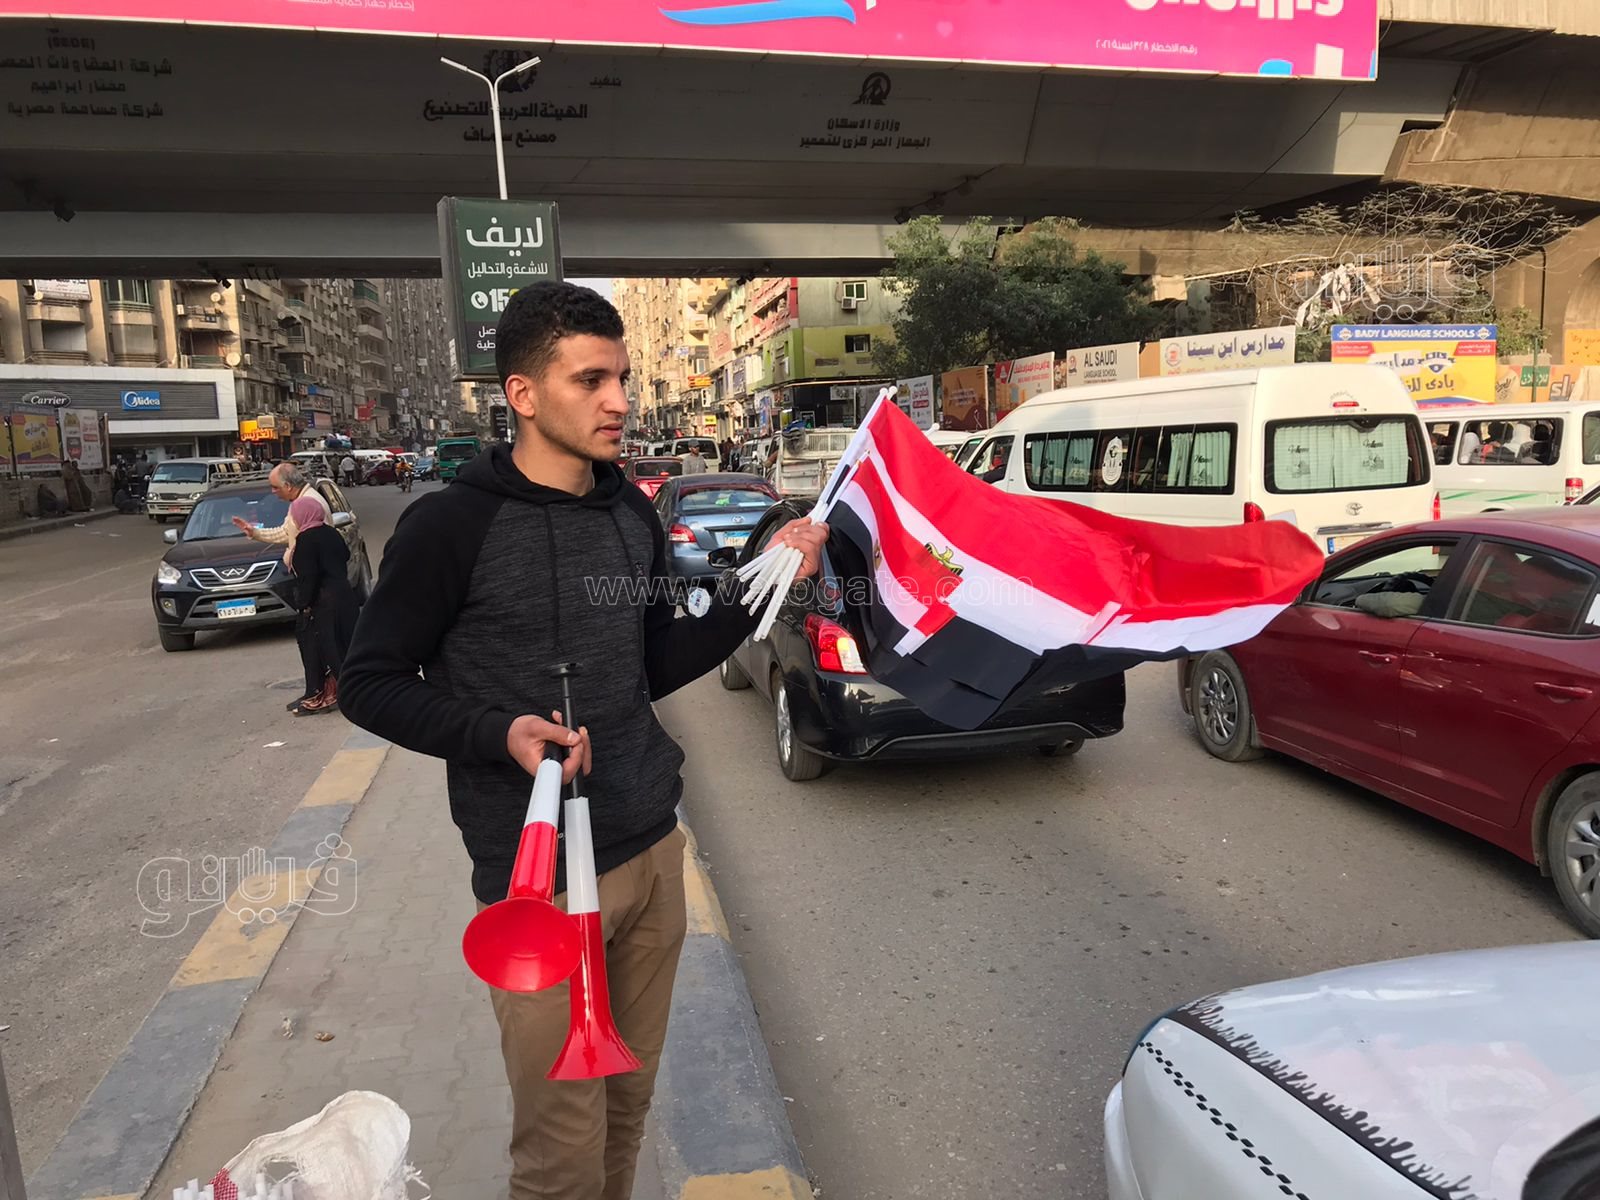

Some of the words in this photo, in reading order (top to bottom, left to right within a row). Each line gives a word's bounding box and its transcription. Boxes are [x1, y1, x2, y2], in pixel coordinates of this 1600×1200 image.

[129, 57, 173, 77] شركة
[61, 102, 118, 116] مساهمة
[122, 102, 164, 119] شركة
[423, 100, 489, 121] للتصنيع
[498, 102, 539, 121] العربي
[541, 103, 588, 121] الهيئة
[873, 118, 901, 133] وزارة
[515, 127, 557, 148] مصنع
[466, 217, 544, 257] لايف
[489, 288, 520, 313] 15
[1354, 329, 1380, 339] BADY
[1381, 329, 1431, 339] LANGUAGE
[1432, 328, 1475, 339] SCHOOLS
[1187, 341, 1214, 361] سينا
[1217, 337, 1237, 358] ابن
[1240, 334, 1286, 356] مدارس
[1084, 352, 1094, 367] AL
[1095, 349, 1118, 366] SAUDI
[30, 394, 67, 406] Carrier
[126, 392, 160, 407] Midea
